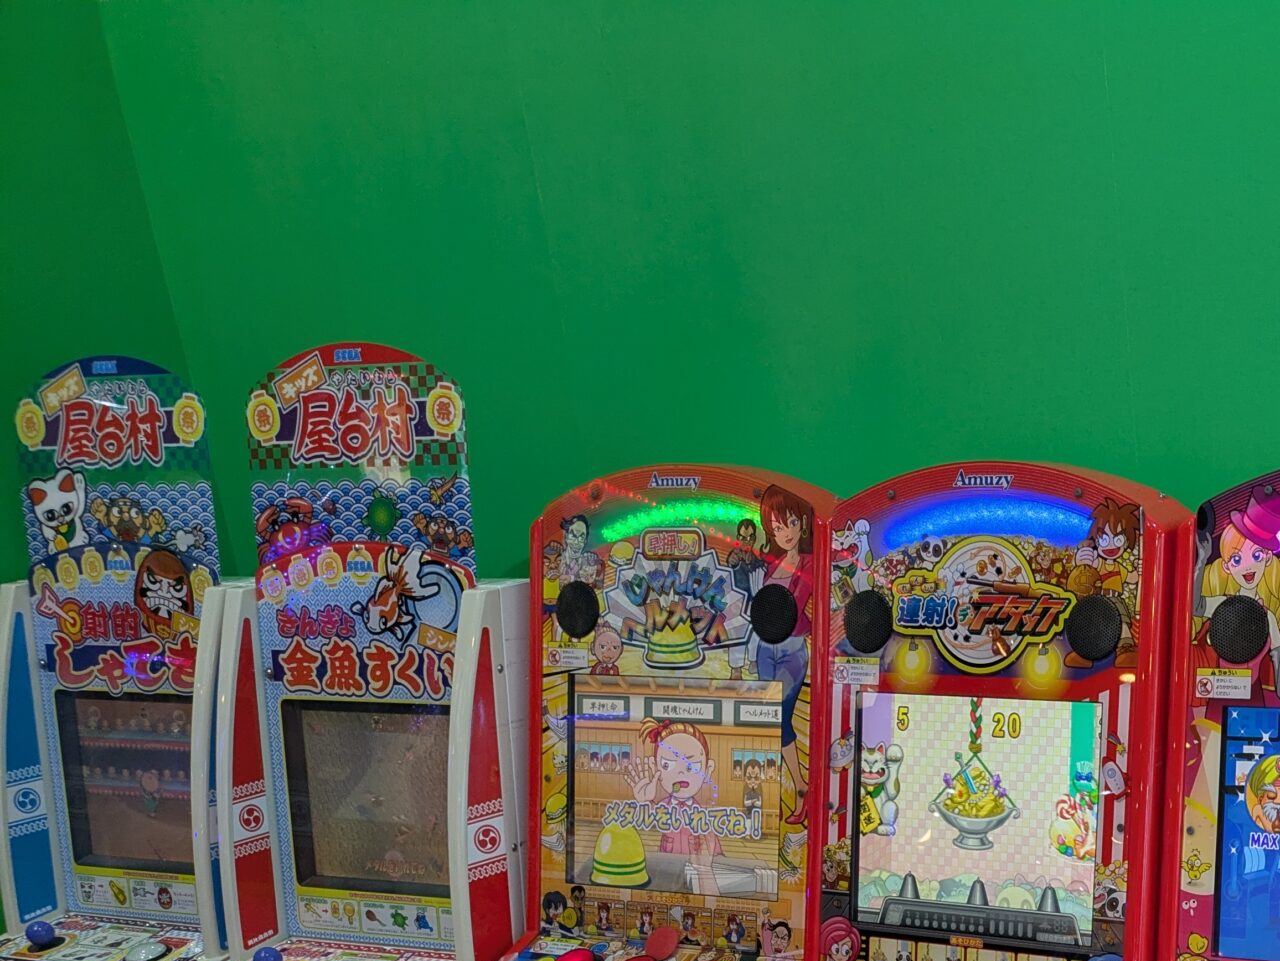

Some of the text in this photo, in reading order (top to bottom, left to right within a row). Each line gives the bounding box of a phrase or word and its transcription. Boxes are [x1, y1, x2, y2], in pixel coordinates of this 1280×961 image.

[334, 348, 362, 362] SEGA
[282, 366, 319, 398] キッズ
[331, 369, 397, 387] やたいむら
[60, 396, 163, 463] 屋台村
[297, 385, 415, 461] 屋台村
[649, 473, 701, 490] Amuzy
[953, 469, 1014, 489] Amuzy
[81, 602, 140, 640] 射的
[277, 604, 357, 638] きんぎょ
[896, 706, 910, 732] 5
[991, 712, 1021, 739] 20
[1250, 832, 1279, 849] MAX
